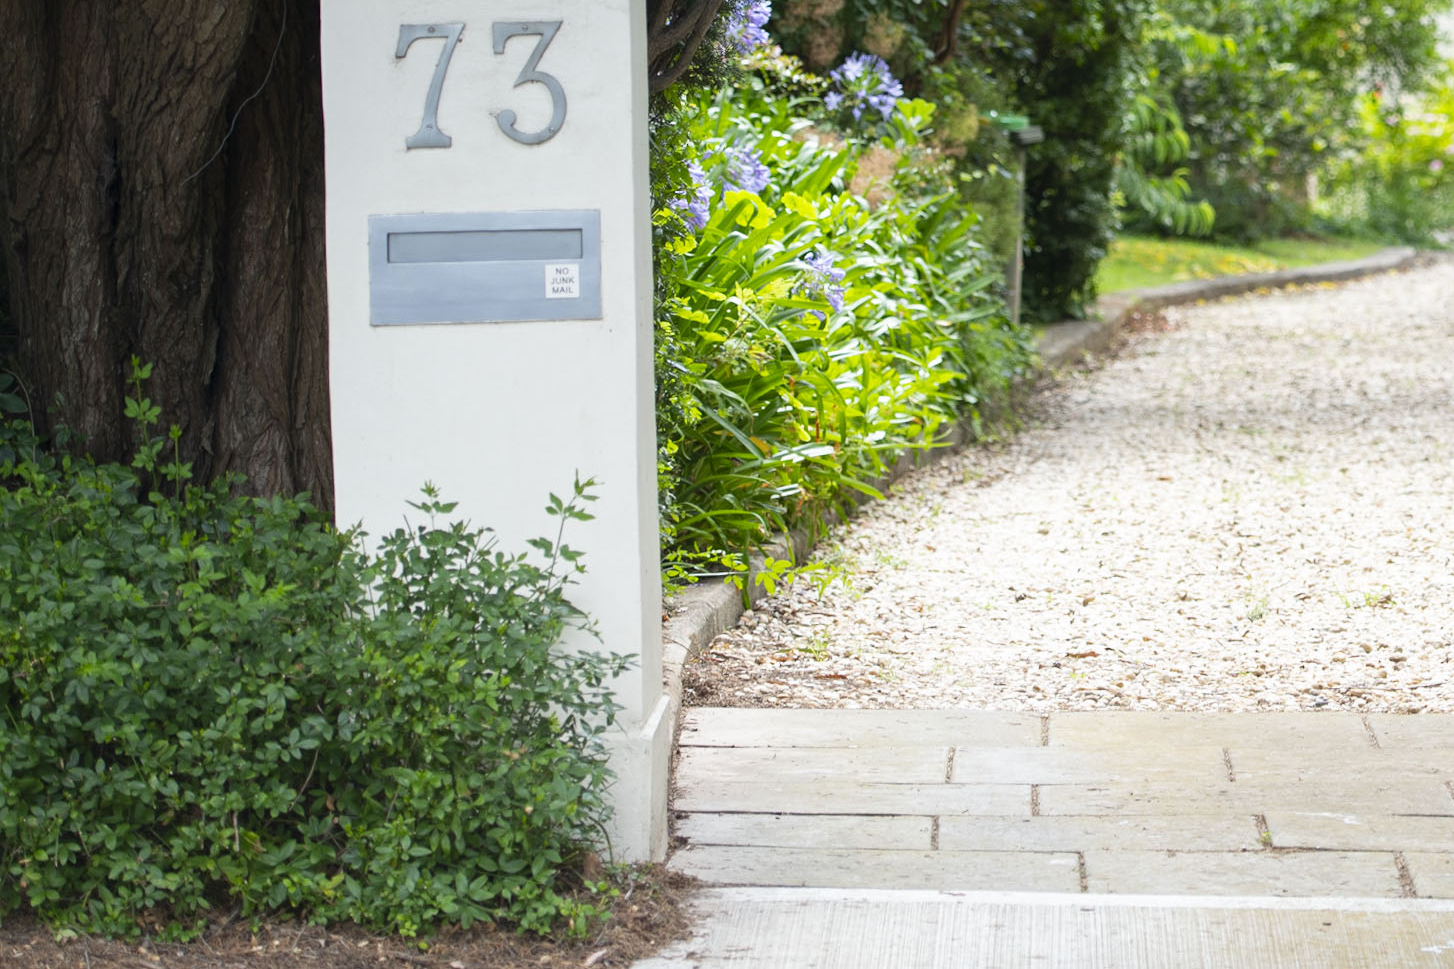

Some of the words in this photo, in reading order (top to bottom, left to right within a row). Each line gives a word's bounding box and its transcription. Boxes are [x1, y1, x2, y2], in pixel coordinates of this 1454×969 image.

[395, 20, 567, 150] 73
[555, 267, 569, 275] NO
[551, 277, 574, 285] JUNK
[552, 286, 574, 294] MAIL
